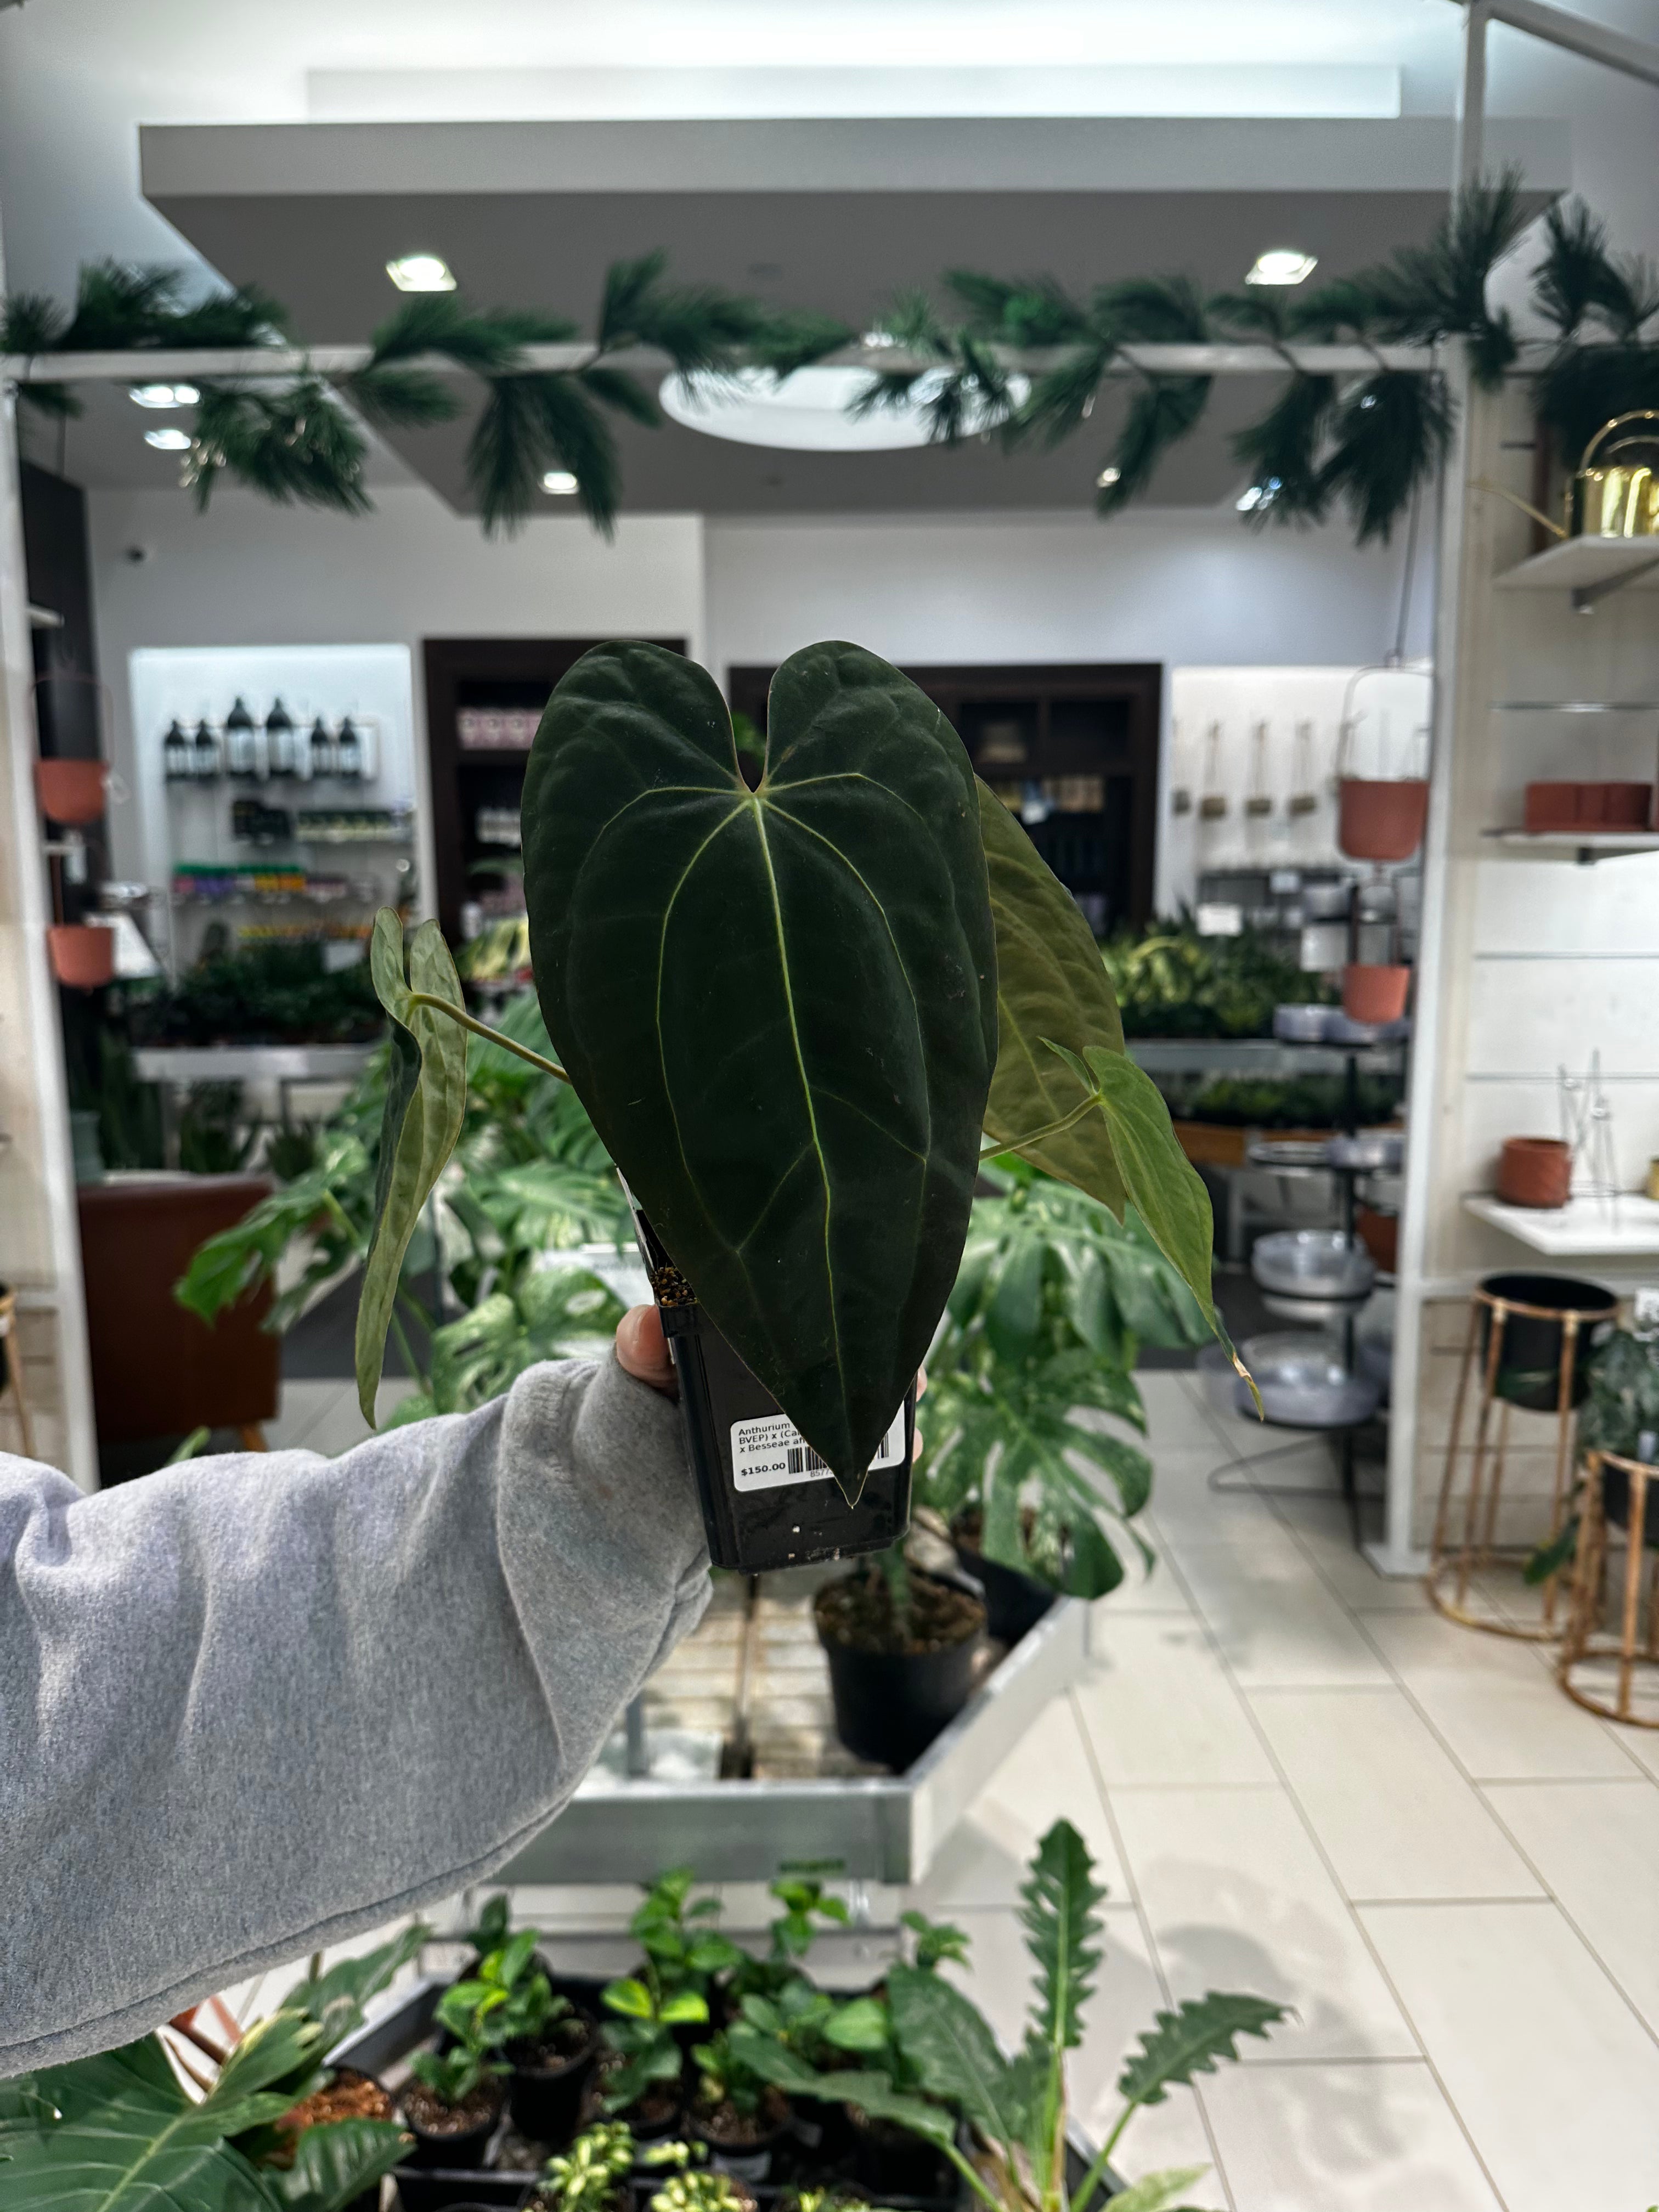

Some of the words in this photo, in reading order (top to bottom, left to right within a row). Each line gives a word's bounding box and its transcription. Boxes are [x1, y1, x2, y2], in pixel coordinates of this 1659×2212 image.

[738, 1423, 790, 1436] Anthurium
[740, 1434, 768, 1444] BVEP)
[748, 1440, 789, 1452] Besseae
[741, 1462, 786, 1476] $150.00
[810, 1468, 833, 1477] 8577
